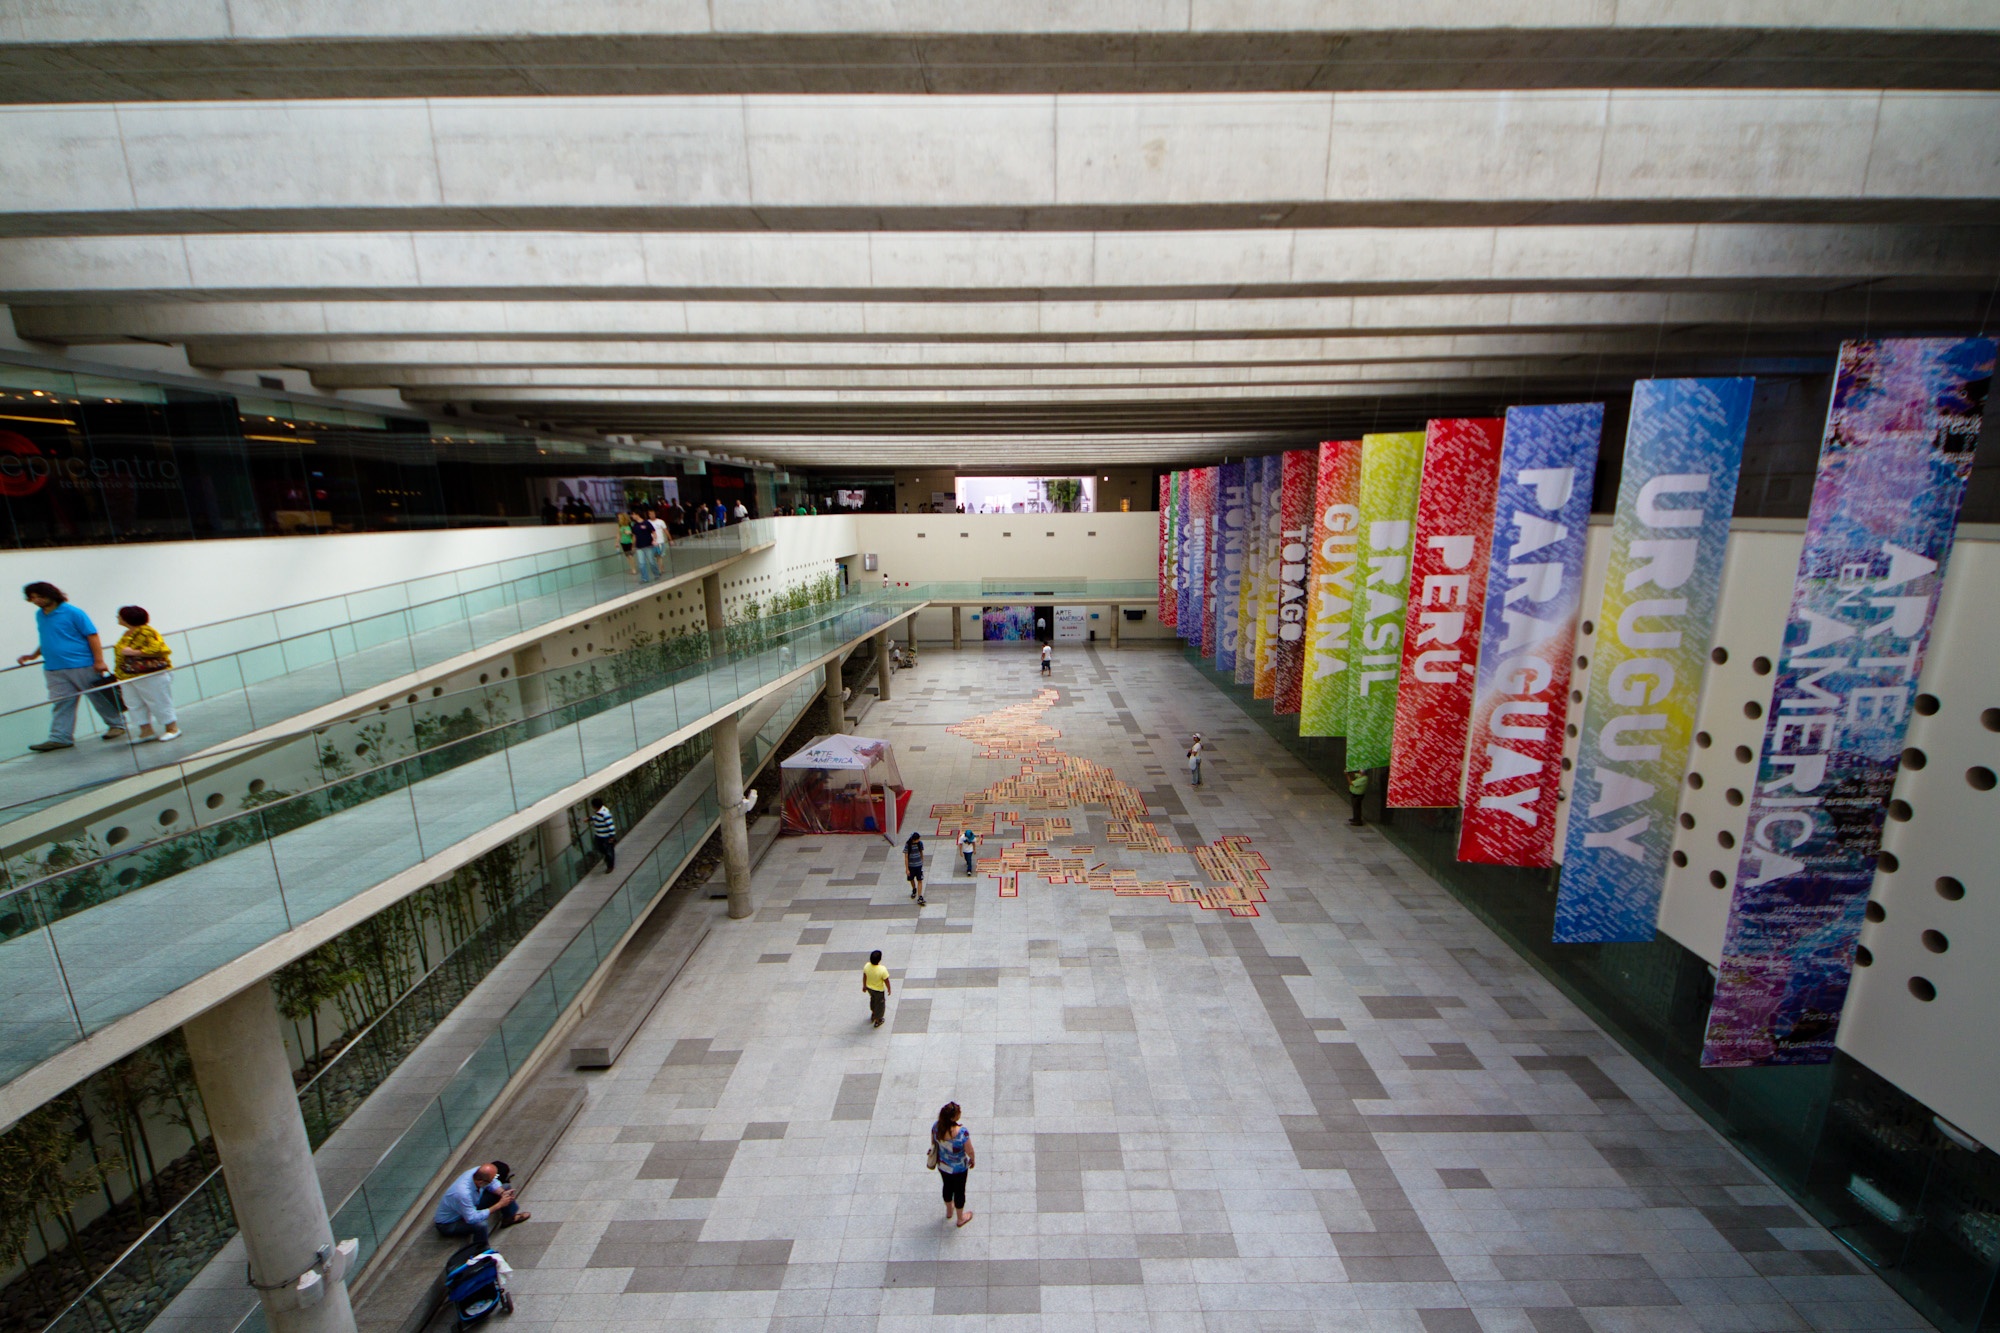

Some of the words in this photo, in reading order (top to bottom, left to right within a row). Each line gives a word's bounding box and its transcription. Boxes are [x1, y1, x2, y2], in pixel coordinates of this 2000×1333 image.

[1, 449, 178, 482] epicentro
[1223, 486, 1246, 652] HONDURAS
[1280, 524, 1307, 641] TOBAGO
[1313, 503, 1359, 680] GUYANA
[1360, 519, 1410, 697] BRASIL
[1414, 535, 1476, 683] PERÚ
[1480, 467, 1574, 826] PARAGUAY
[1833, 562, 1870, 607] EN
[1850, 541, 1938, 724] ARTE
[1584, 473, 1709, 863] URUGUAY
